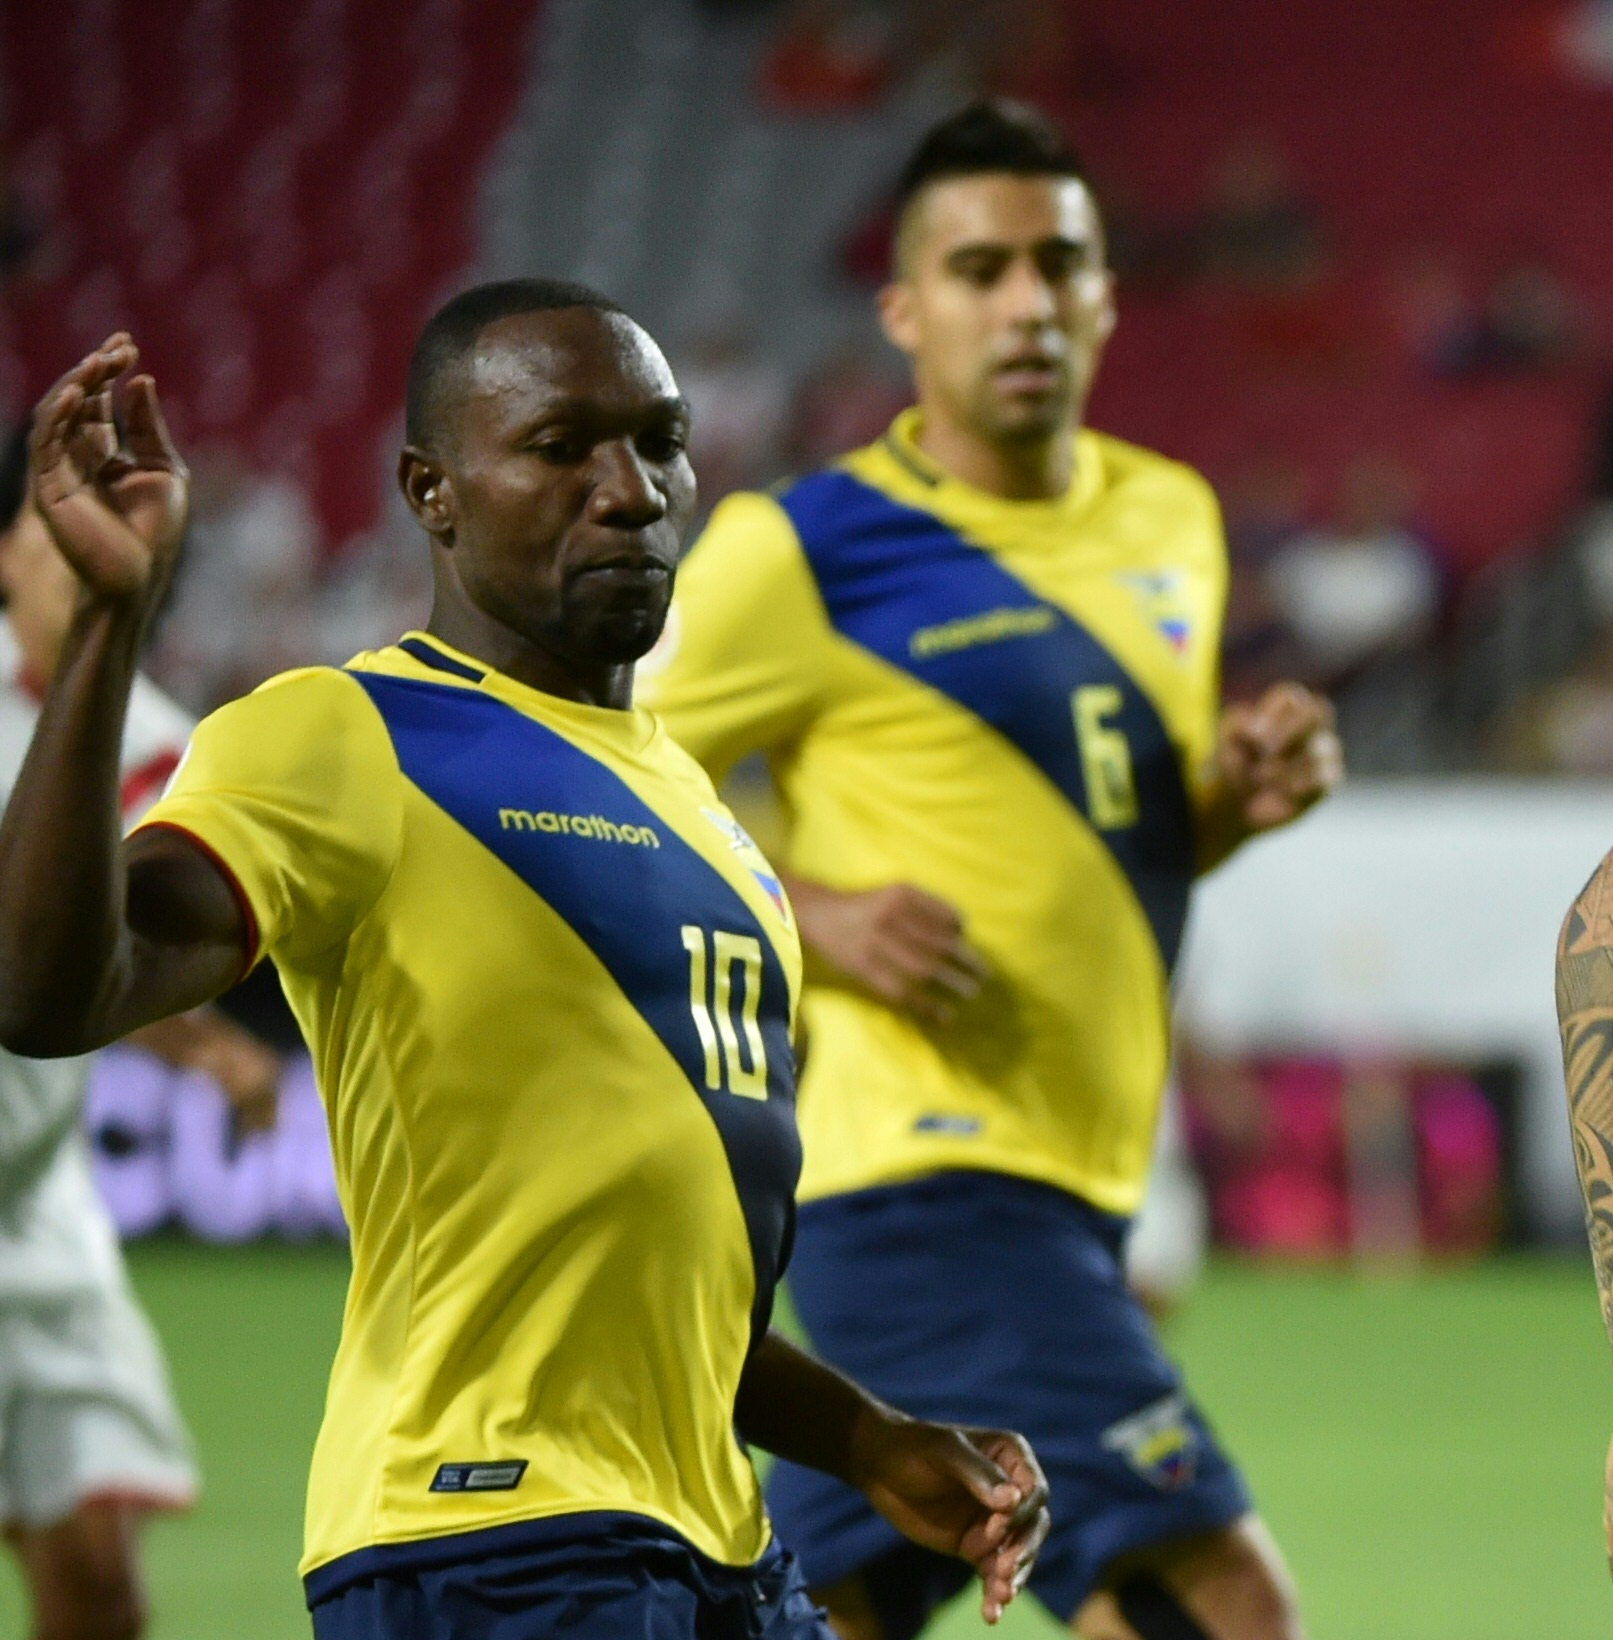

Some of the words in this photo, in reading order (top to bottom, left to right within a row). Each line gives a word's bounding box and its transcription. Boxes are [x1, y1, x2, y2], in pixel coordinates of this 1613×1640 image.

[499, 807, 660, 848] marathon
[1070, 684, 1139, 831] 6
[680, 924, 768, 1101] 10
